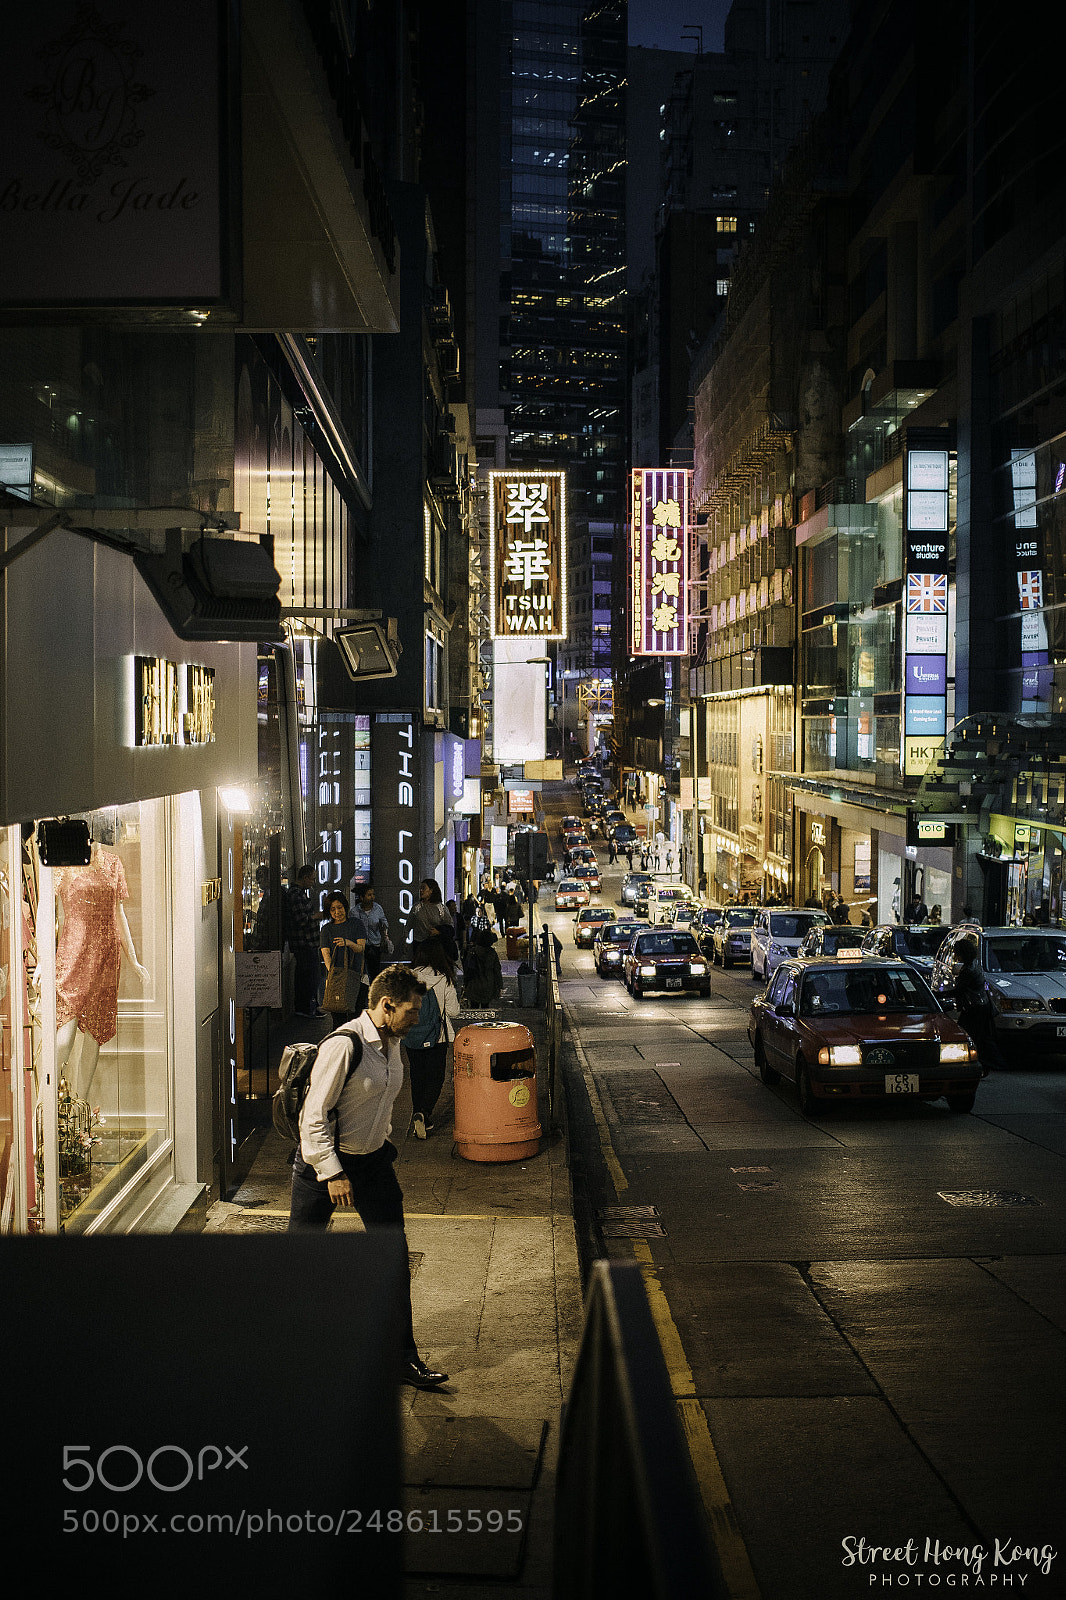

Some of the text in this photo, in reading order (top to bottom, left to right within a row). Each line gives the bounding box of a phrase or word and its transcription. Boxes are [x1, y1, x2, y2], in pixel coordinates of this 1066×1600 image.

[96, 177, 200, 223] Jade
[504, 483, 550, 590] 翠華
[910, 543, 945, 552] venture
[505, 595, 551, 611] TSUI
[506, 615, 551, 631] WAH
[910, 746, 938, 758] HKT
[398, 725, 413, 808] THE
[895, 1075, 909, 1083] CR
[891, 1084, 914, 1092] 1631
